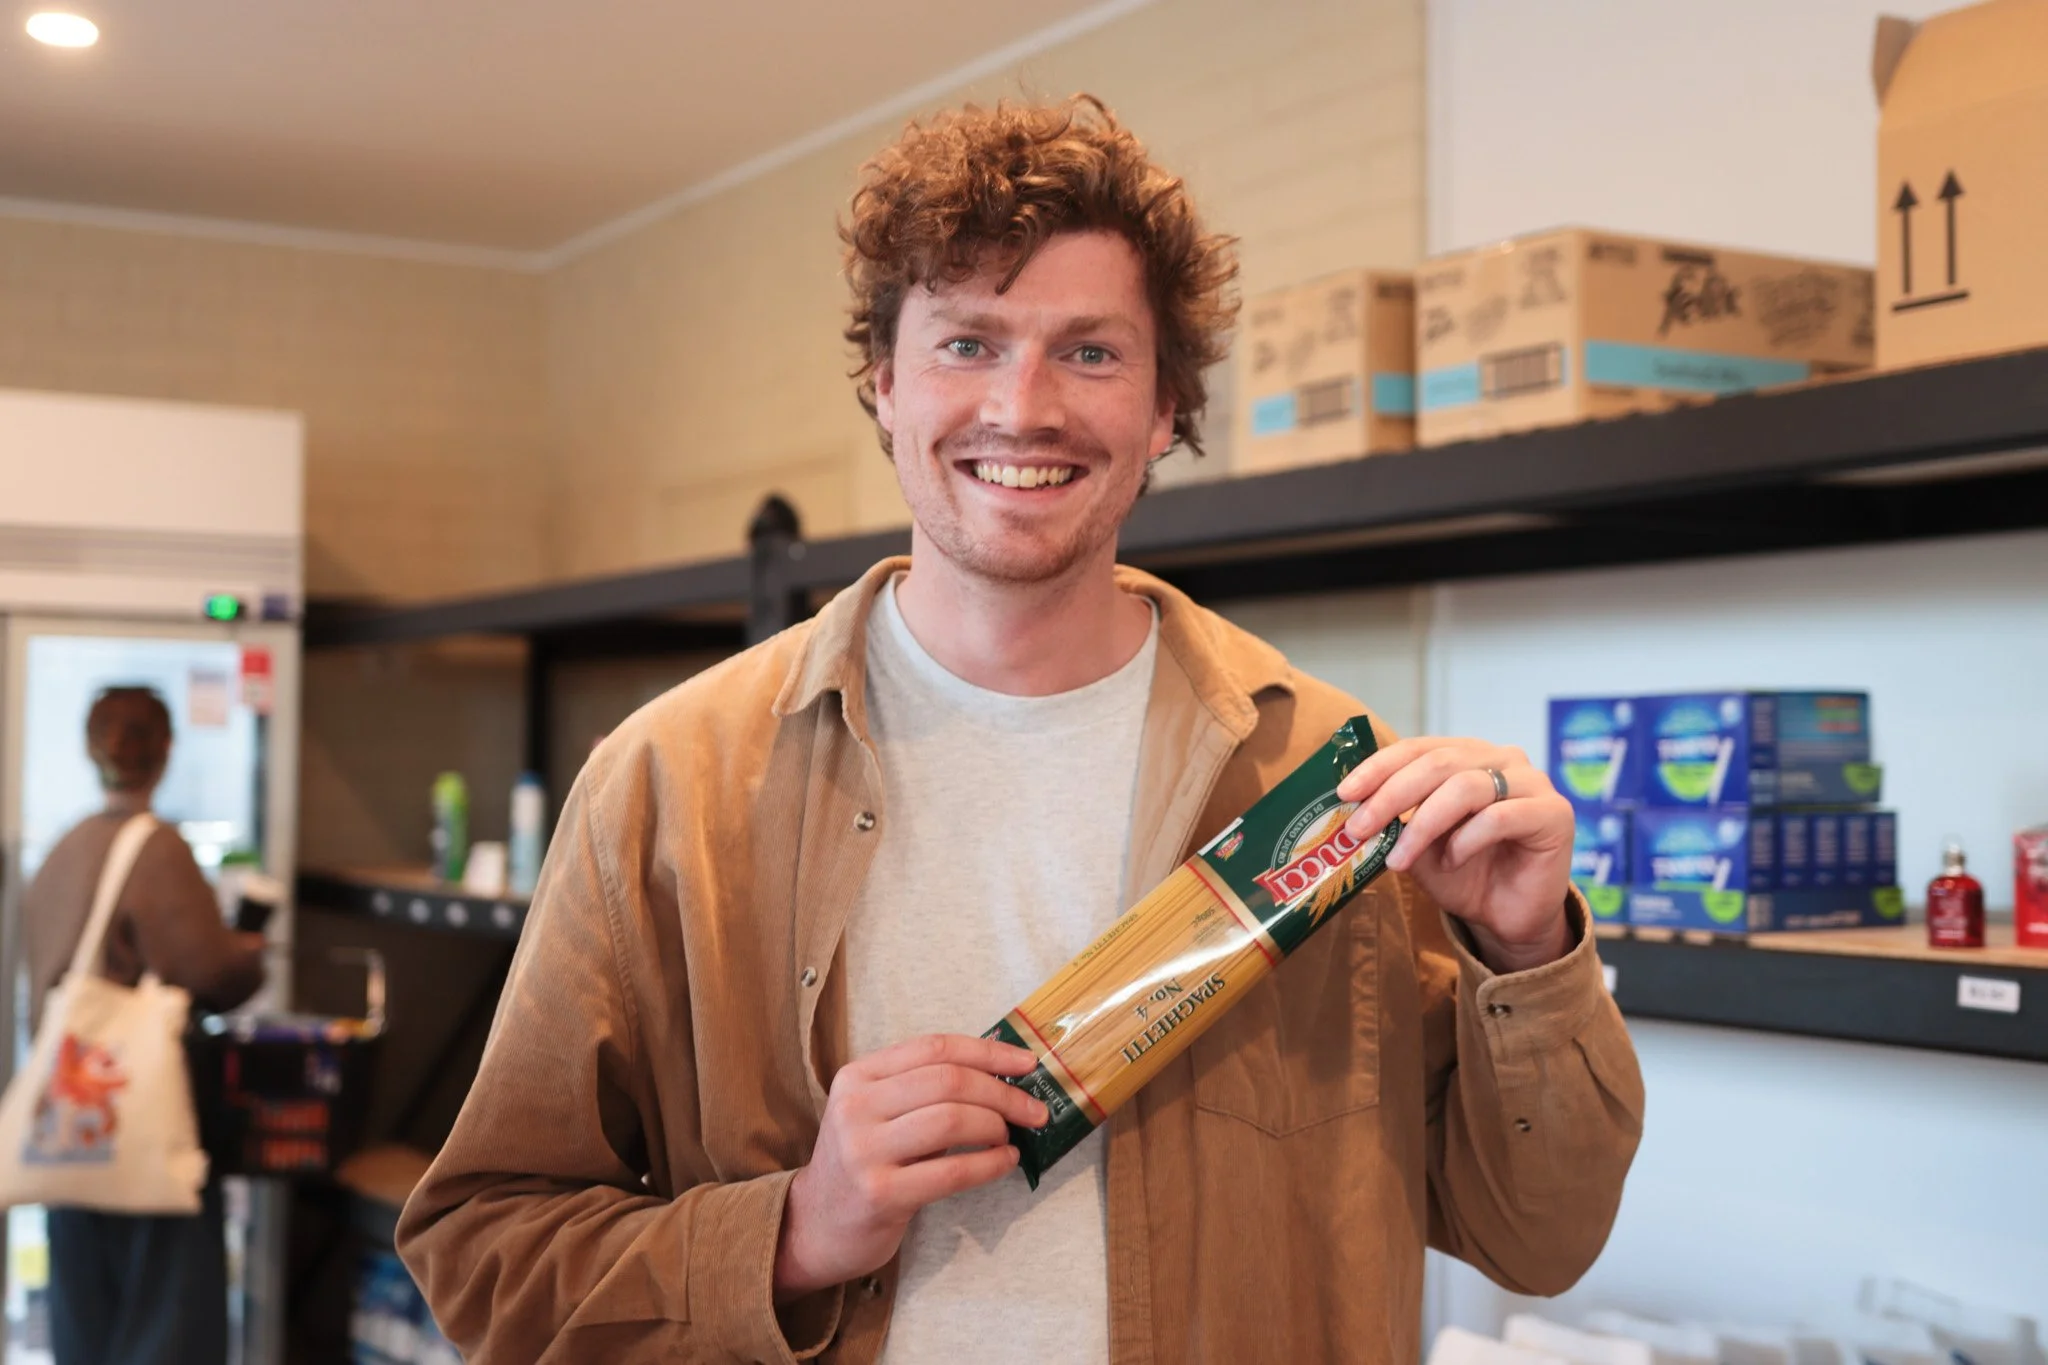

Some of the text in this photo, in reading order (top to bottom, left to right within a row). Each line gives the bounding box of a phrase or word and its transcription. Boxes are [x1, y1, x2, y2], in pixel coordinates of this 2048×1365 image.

[1277, 802, 1325, 864] DI GRANO DURO
[1274, 829, 1361, 898] DUCCI
[1354, 853, 1383, 880] SEMOLA
[1120, 972, 1225, 1064] SPAGHETTI
[1135, 977, 1185, 1022] No. 4
[1032, 1069, 1068, 1113] PAGHETTI
